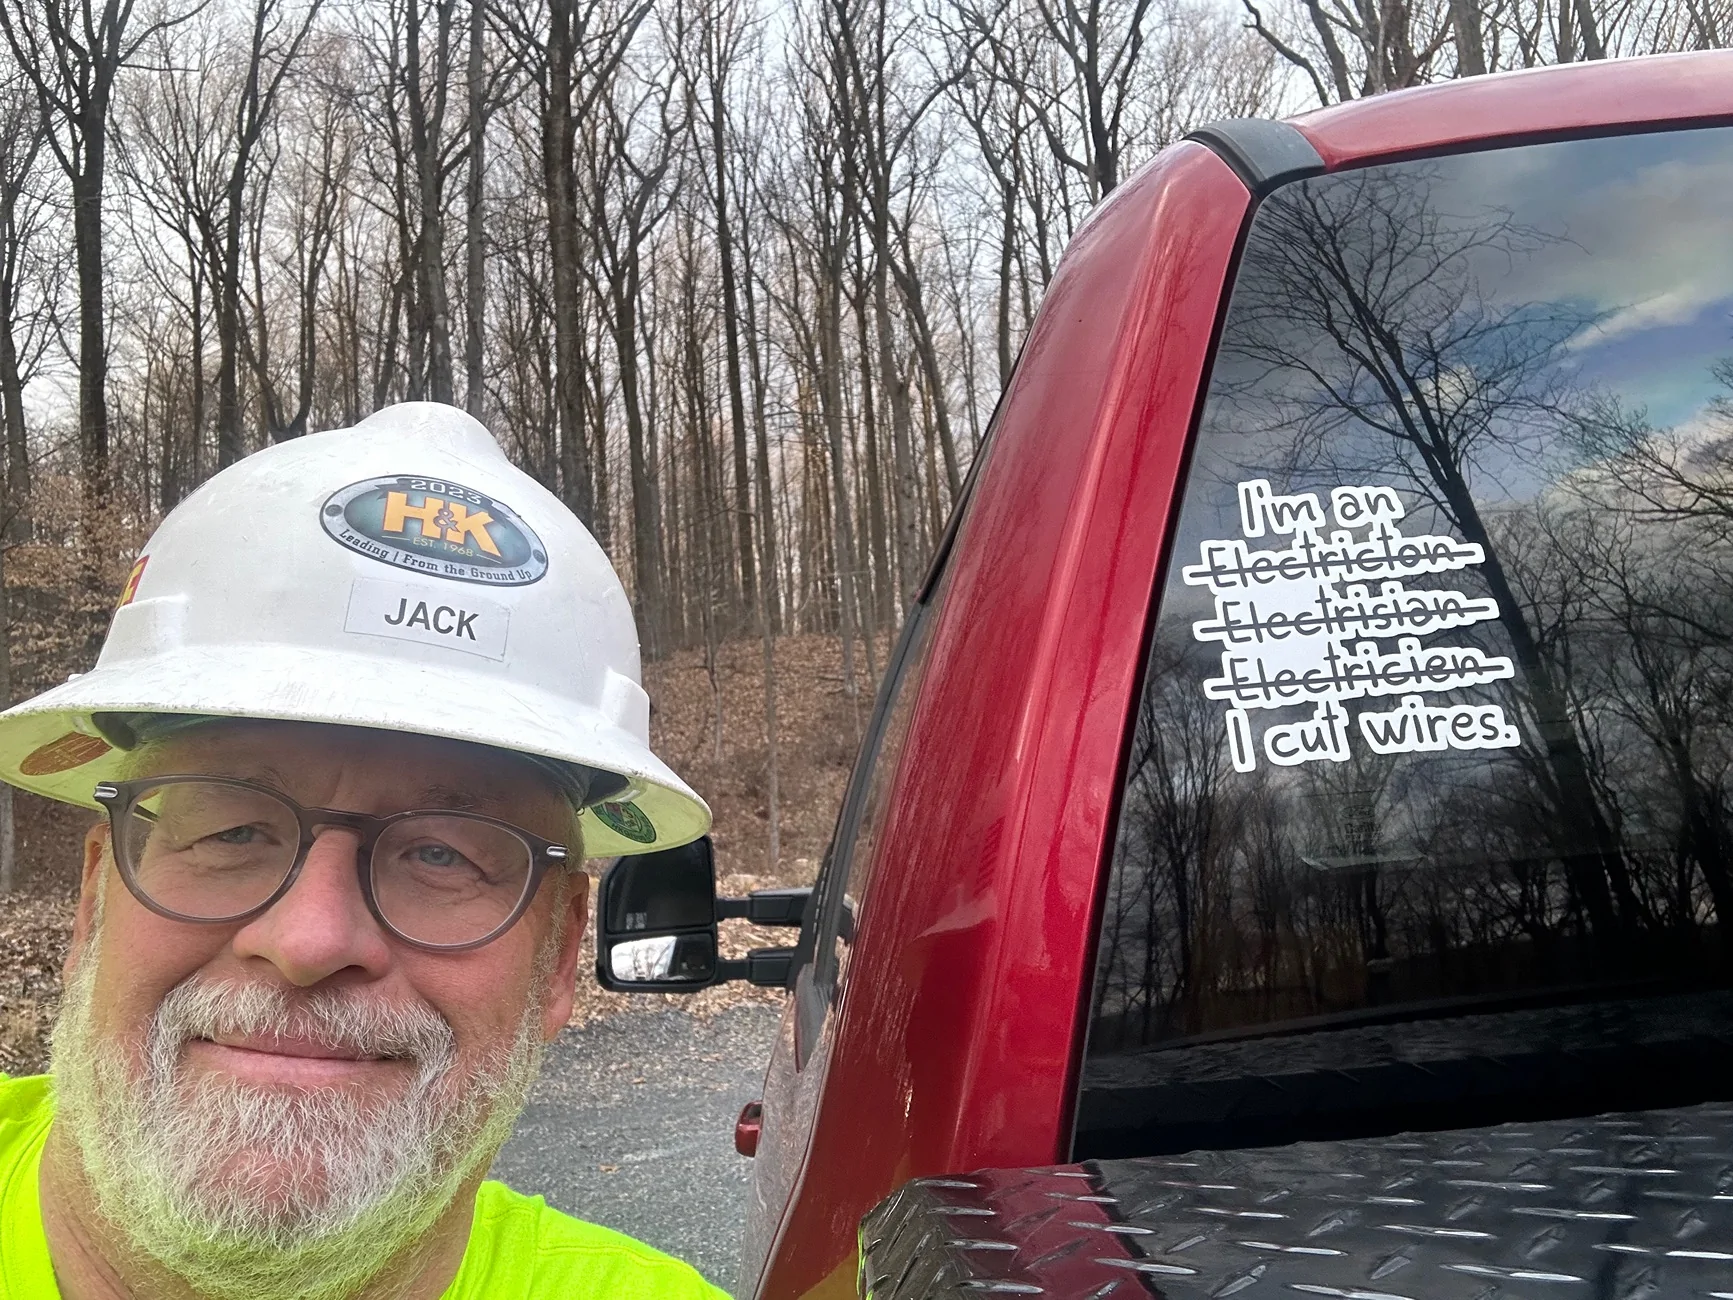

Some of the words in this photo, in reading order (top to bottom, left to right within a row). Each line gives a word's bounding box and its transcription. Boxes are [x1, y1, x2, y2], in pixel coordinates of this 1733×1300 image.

[411, 480, 482, 505] 2023
[1244, 485, 1317, 531] I'm
[1337, 491, 1397, 519] an
[383, 491, 502, 557] H&K
[413, 537, 436, 549] EST.
[443, 541, 474, 557] 1968
[339, 529, 389, 559] Leading
[402, 554, 438, 571] From
[444, 564, 465, 576] the
[471, 568, 516, 581] Ground
[520, 569, 532, 581] Up
[384, 598, 479, 641] JACK
[1223, 585, 1466, 643] Electrisian
[1230, 641, 1484, 701] Electricien
[1233, 717, 1246, 765] I
[1271, 700, 1341, 757] cut
[1366, 702, 1511, 746] wires.
